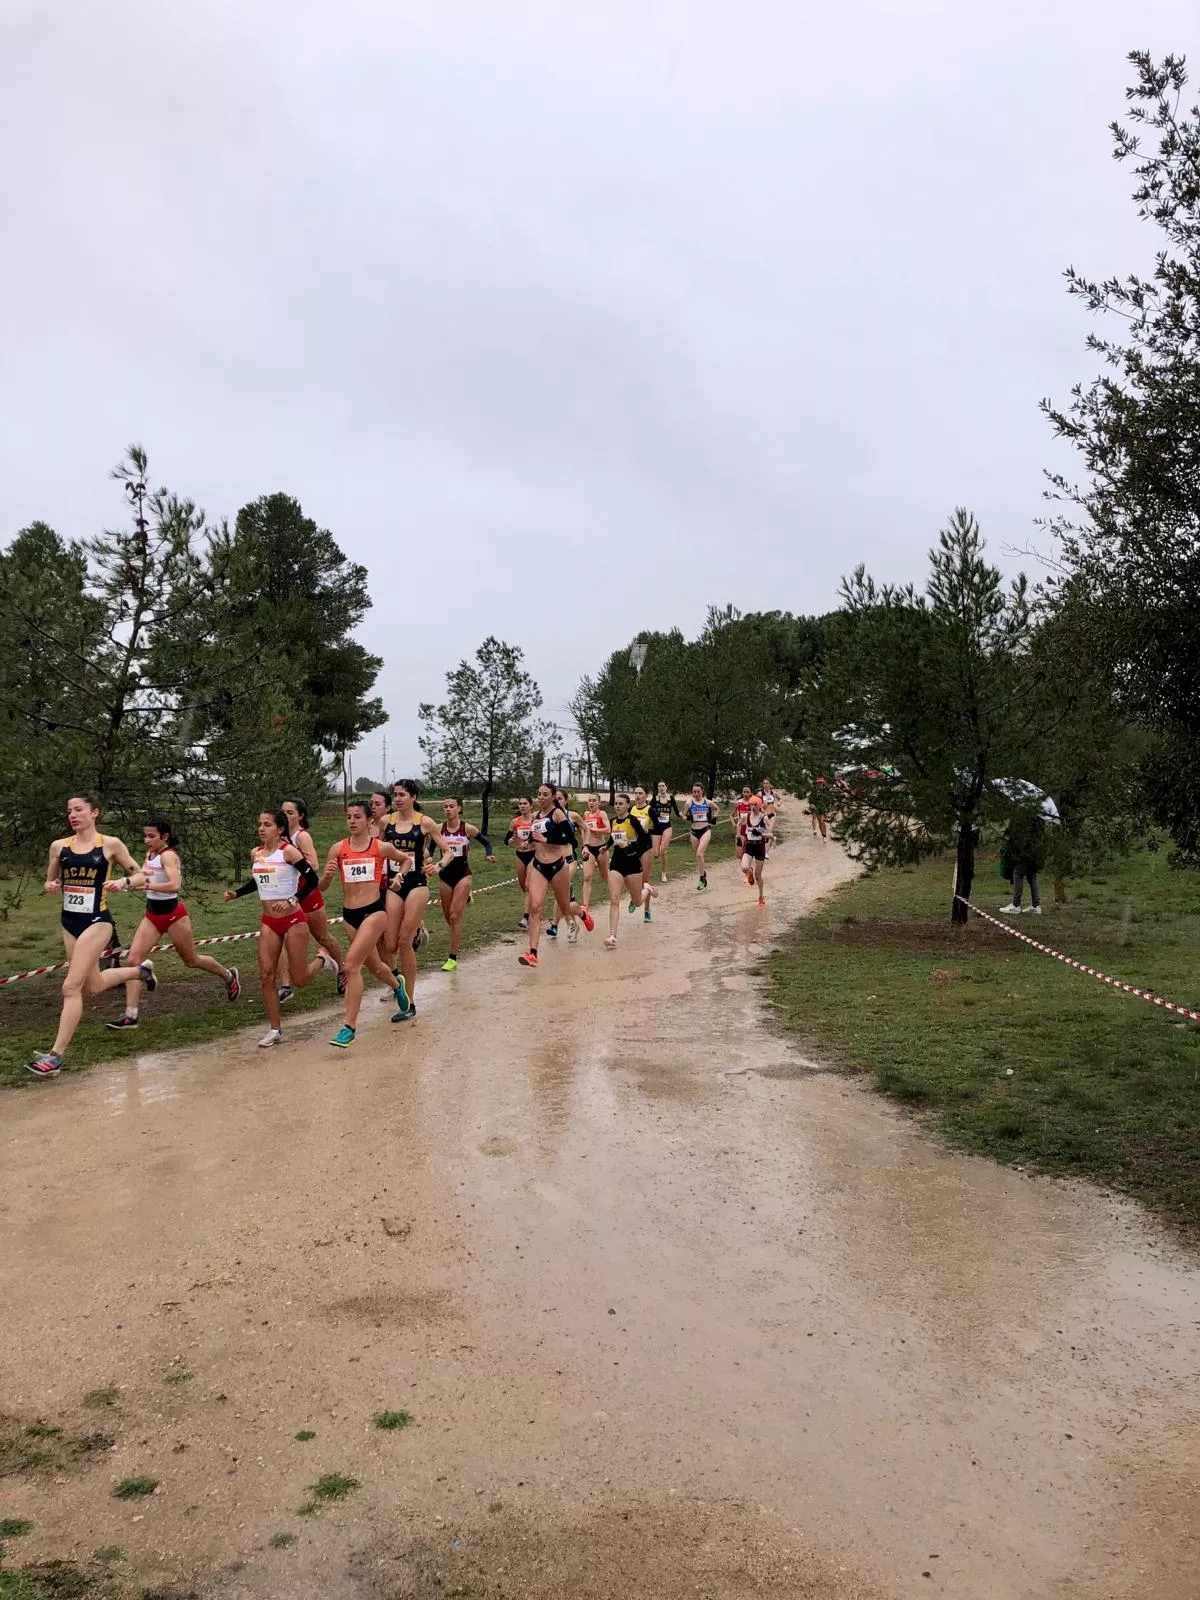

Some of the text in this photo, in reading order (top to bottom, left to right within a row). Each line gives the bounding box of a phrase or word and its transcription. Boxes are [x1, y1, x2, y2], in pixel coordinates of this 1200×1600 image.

[391, 839, 415, 848] CAM
[350, 866, 367, 876] 284
[68, 894, 84, 905] 223
